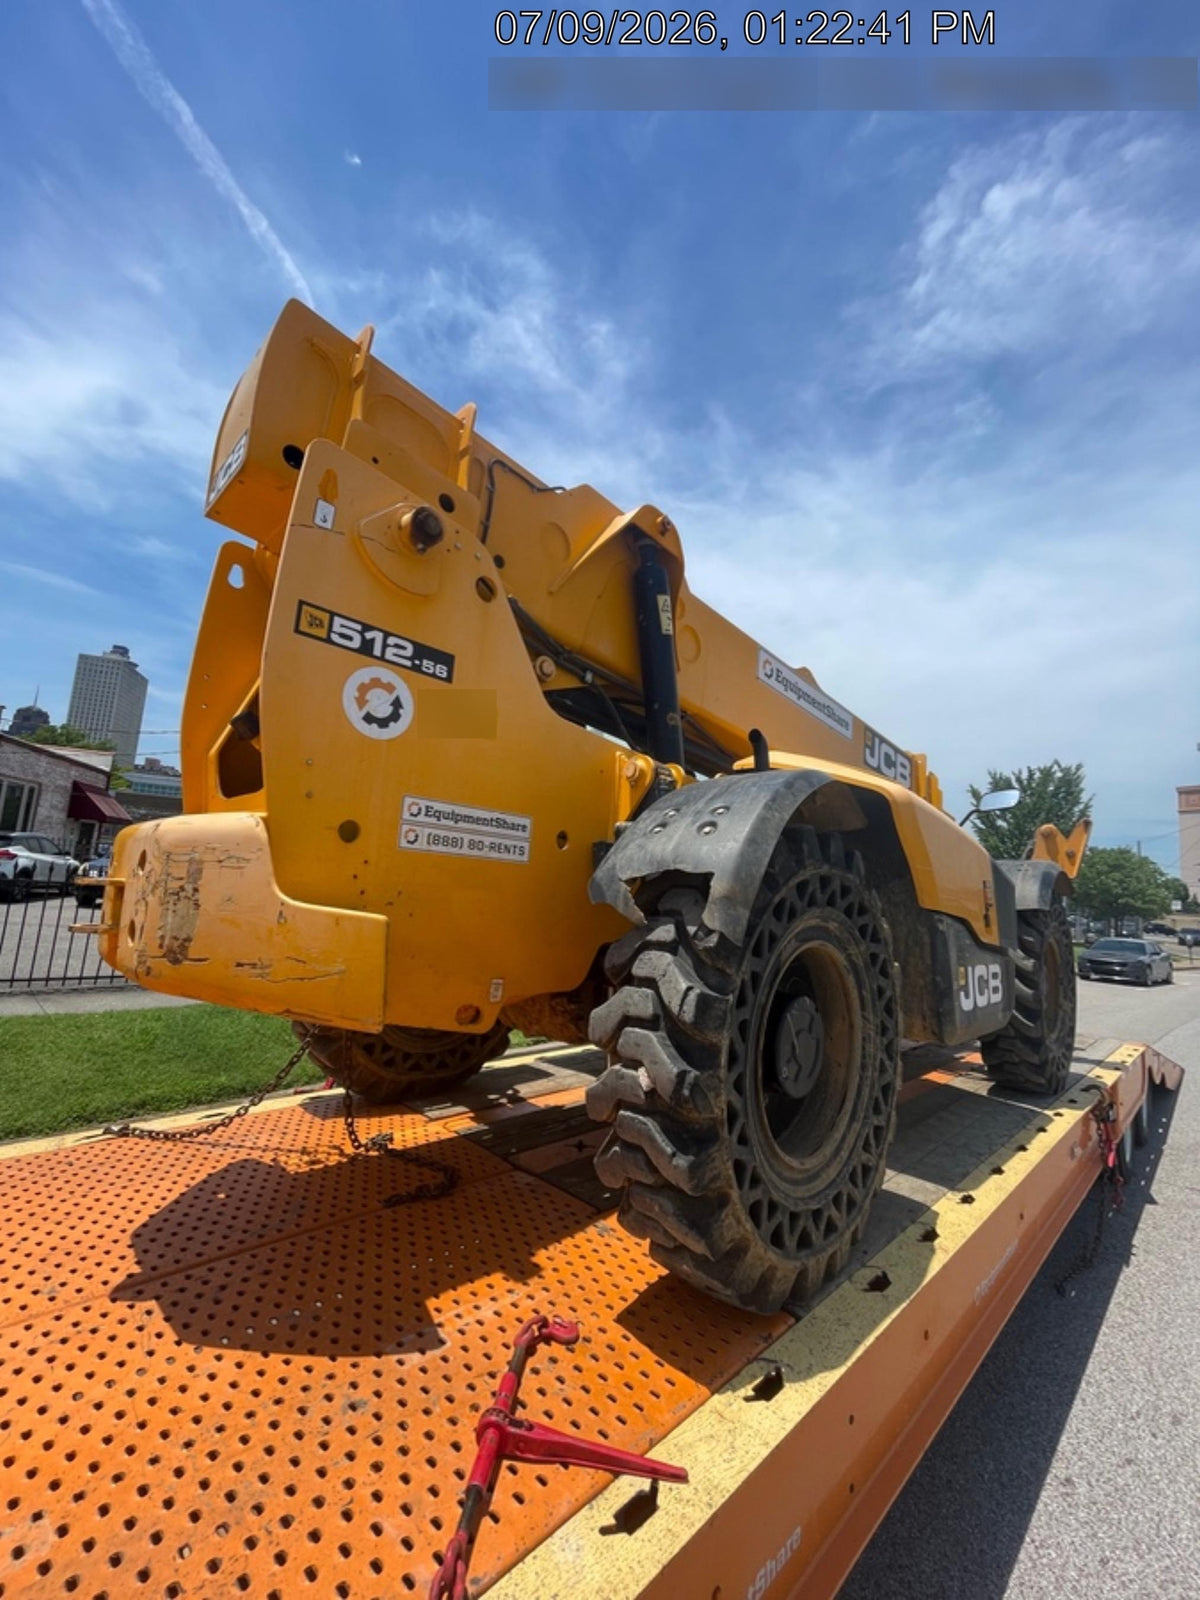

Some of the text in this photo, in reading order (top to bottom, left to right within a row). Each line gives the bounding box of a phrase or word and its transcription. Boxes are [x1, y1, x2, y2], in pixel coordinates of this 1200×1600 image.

[775, 667, 850, 731] EquipmentShare
[865, 736, 911, 788] JCB
[424, 804, 528, 833] EquipmentShare
[426, 831, 526, 857] (888) 80-RENTS
[960, 964, 1003, 1011] JCB
